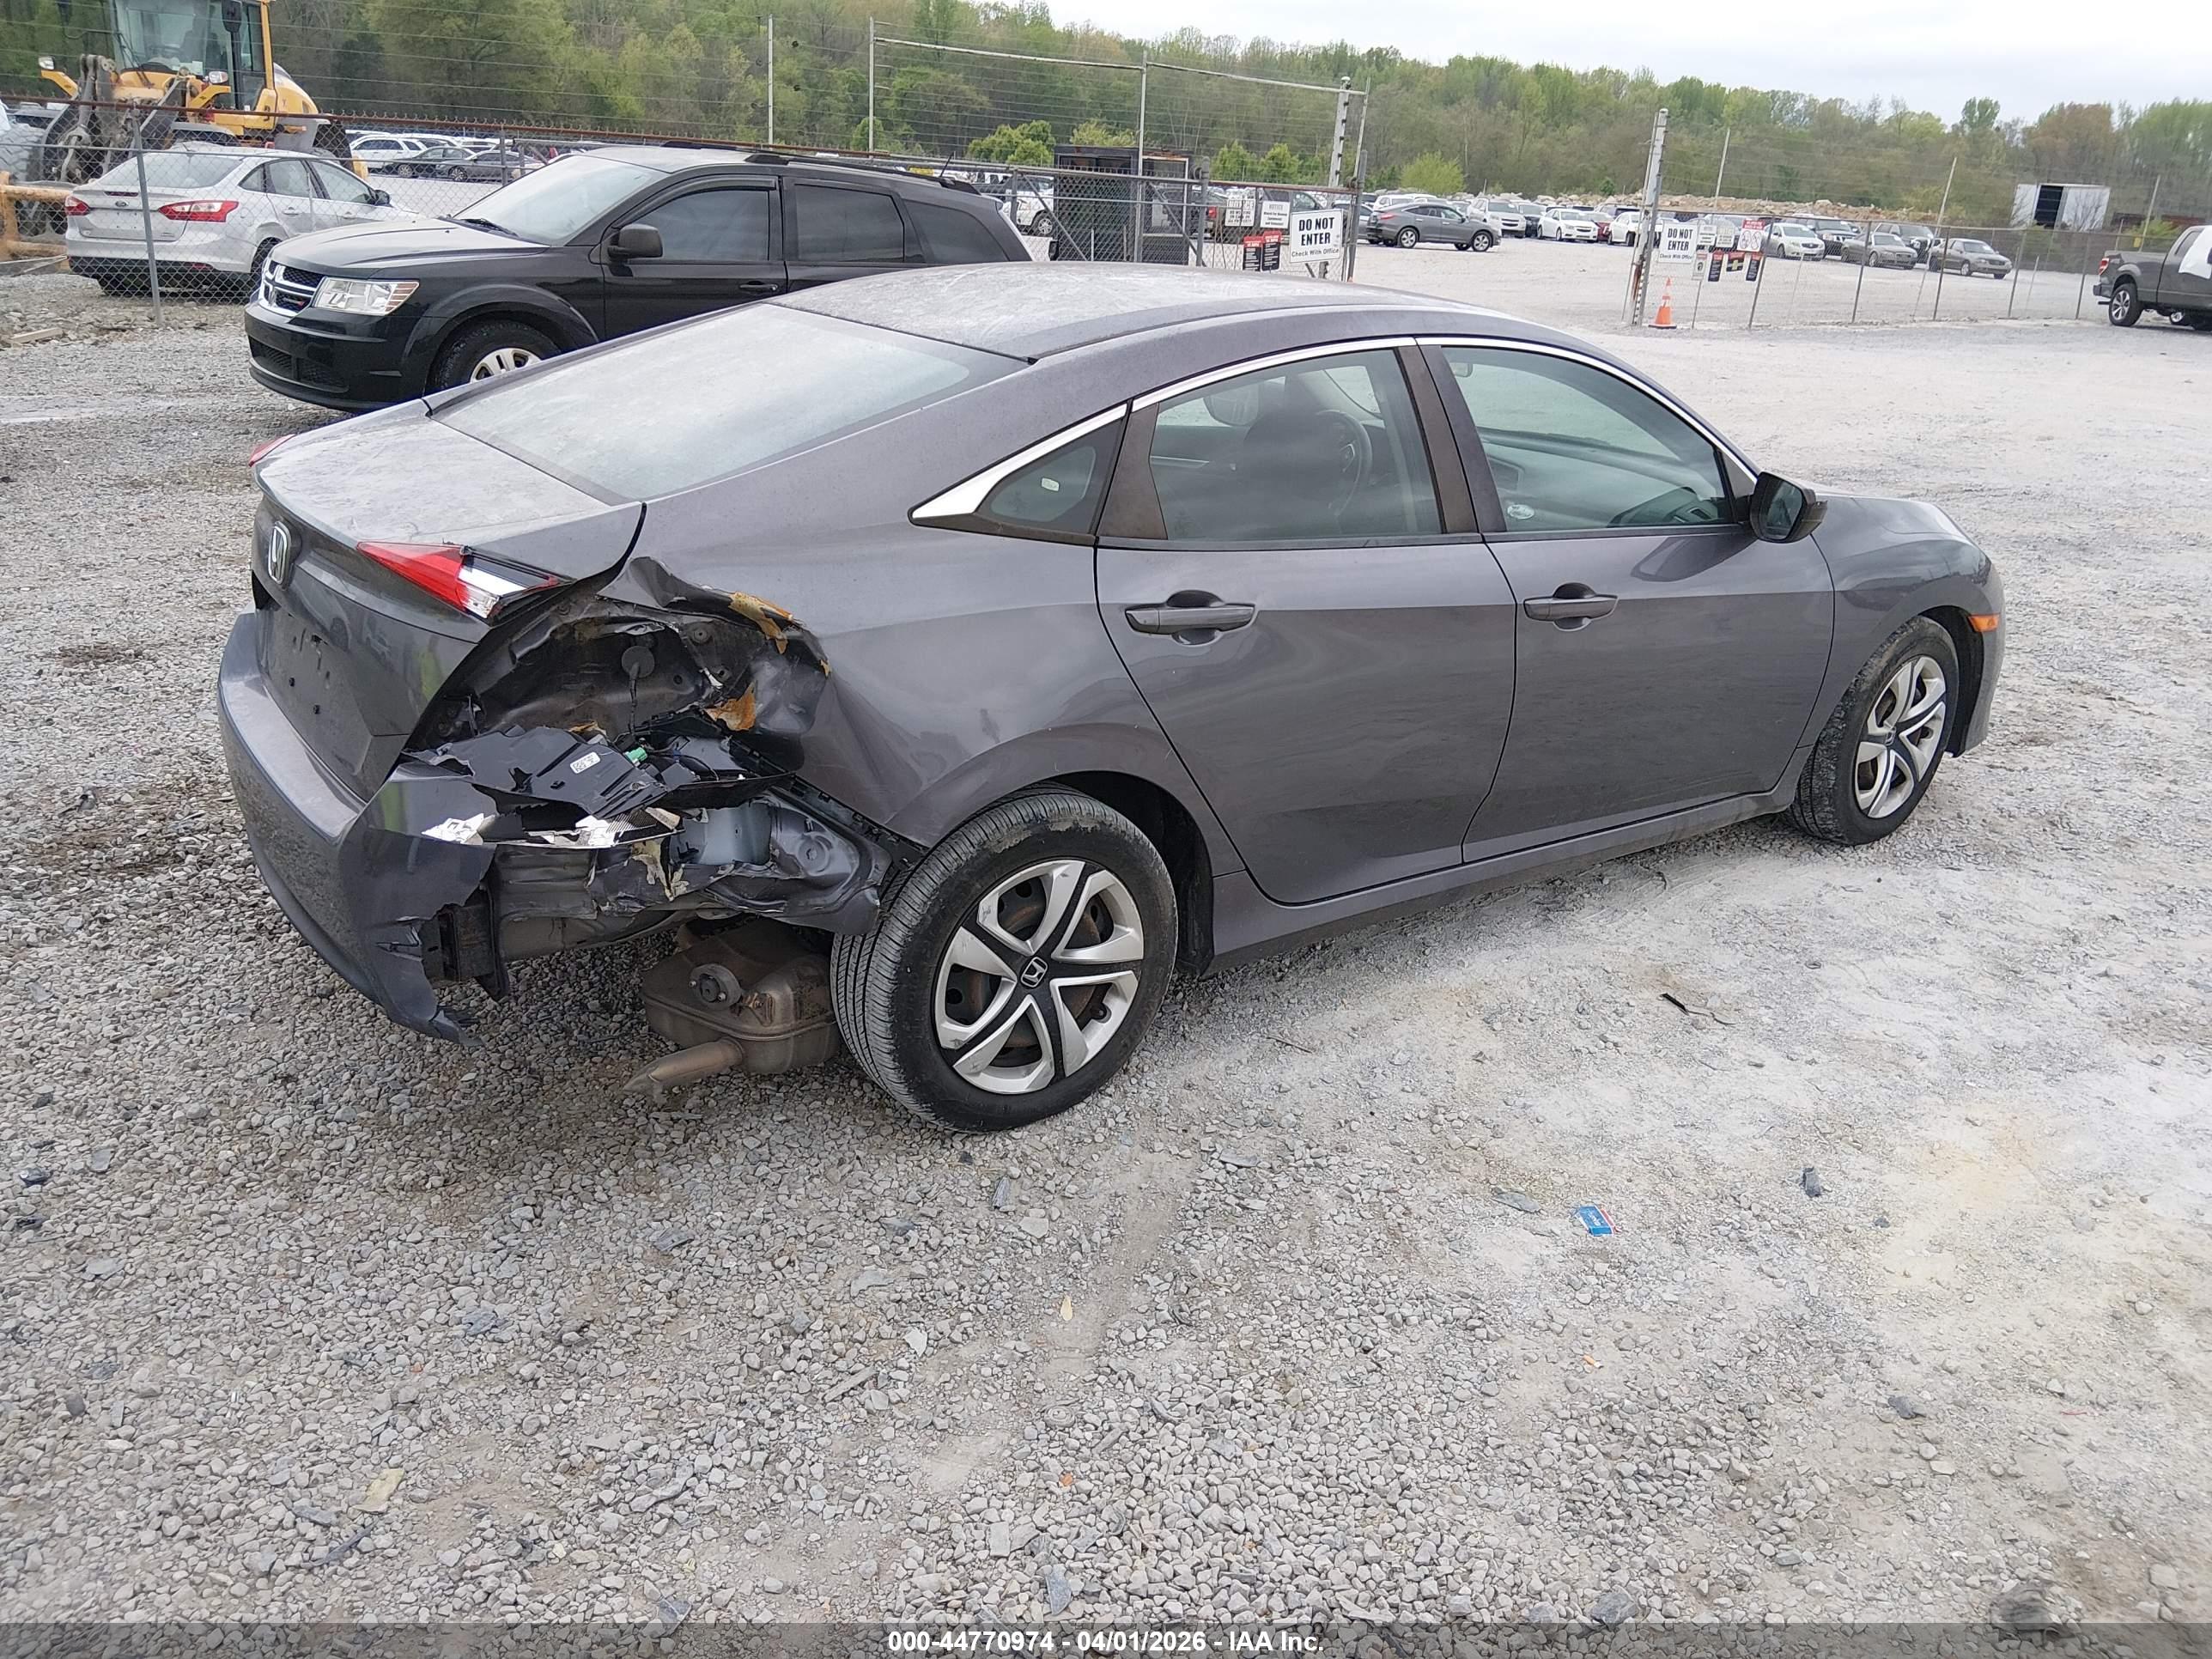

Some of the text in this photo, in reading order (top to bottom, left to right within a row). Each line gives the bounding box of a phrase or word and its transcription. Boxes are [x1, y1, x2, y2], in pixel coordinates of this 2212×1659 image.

[1298, 216, 1335, 232] DO NOT
[1301, 232, 1331, 246] ENTER
[1668, 228, 1678, 239] DO
[1679, 228, 1693, 240] NOT
[1668, 240, 1689, 251] ENTER
